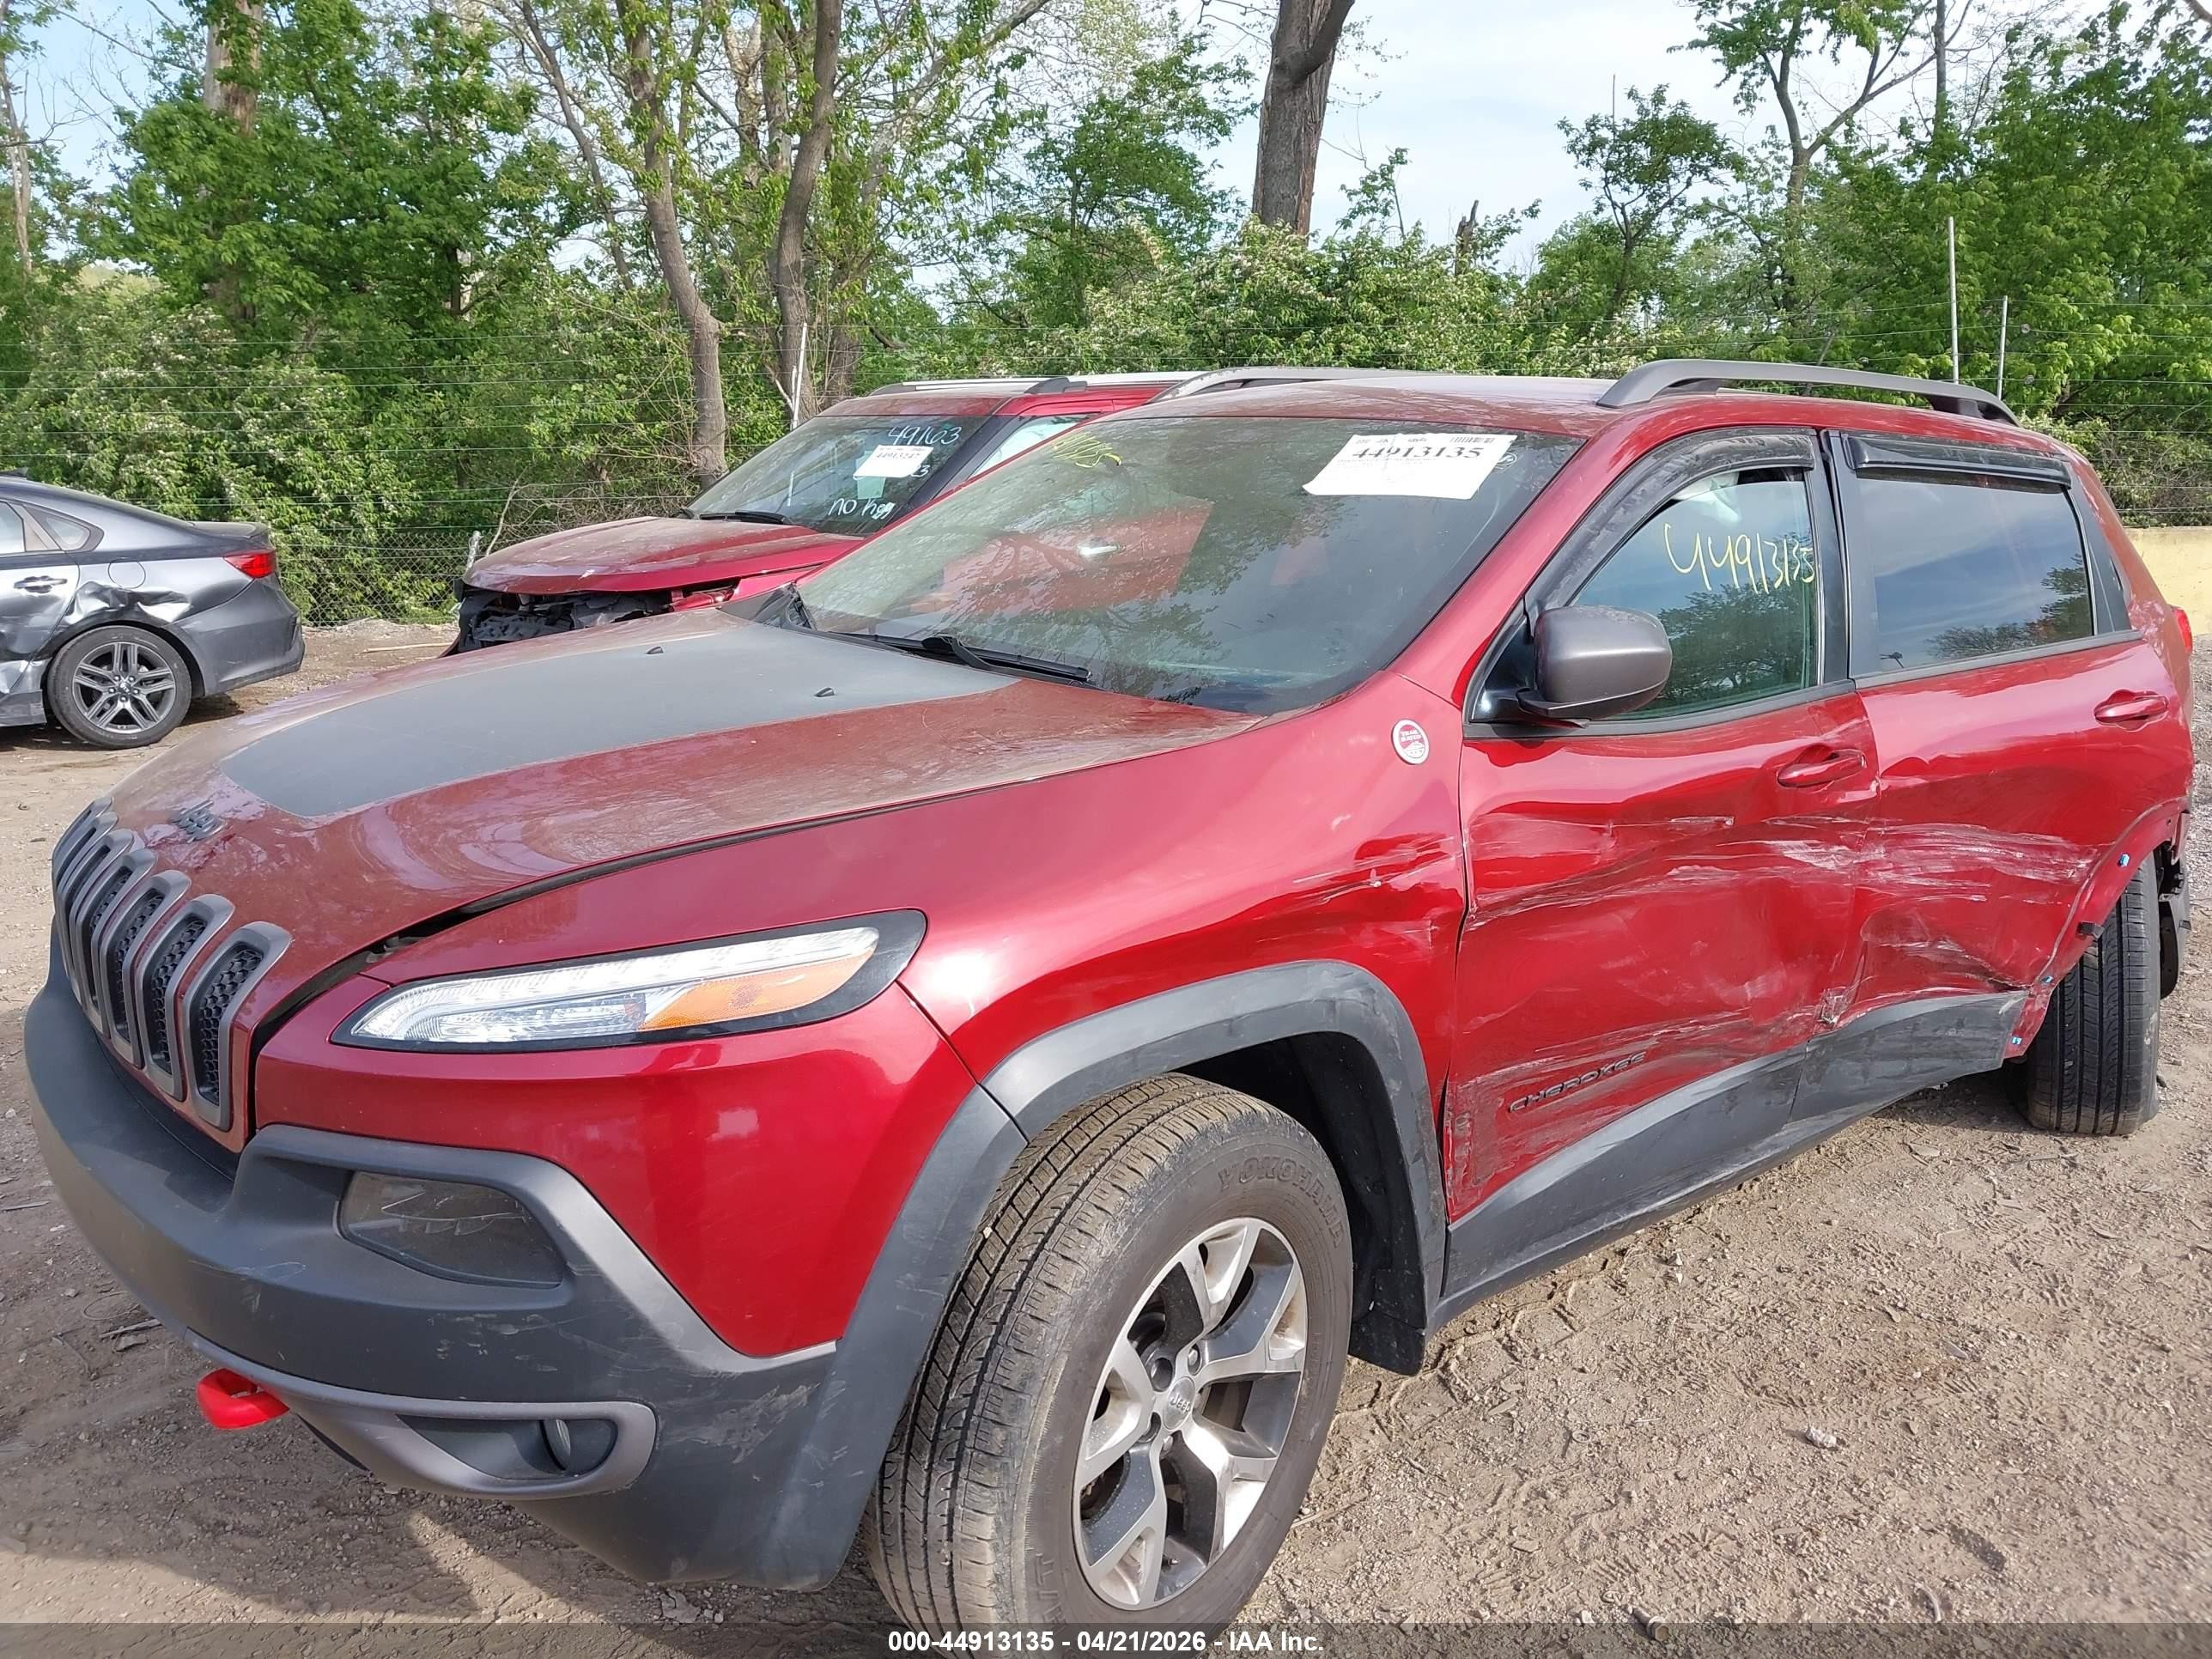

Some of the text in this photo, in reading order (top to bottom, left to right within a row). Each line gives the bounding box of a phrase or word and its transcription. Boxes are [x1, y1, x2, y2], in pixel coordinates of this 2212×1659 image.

[887, 425, 963, 446] 49163
[1352, 446, 1485, 459] 44913135
[827, 497, 858, 516] no
[1664, 522, 1814, 594] 44913135
[1508, 1050, 1647, 1114] CHEROKEE
[1218, 1155, 1346, 1249] YOKOHAMA
[1169, 1391, 1191, 1414] Jeep
